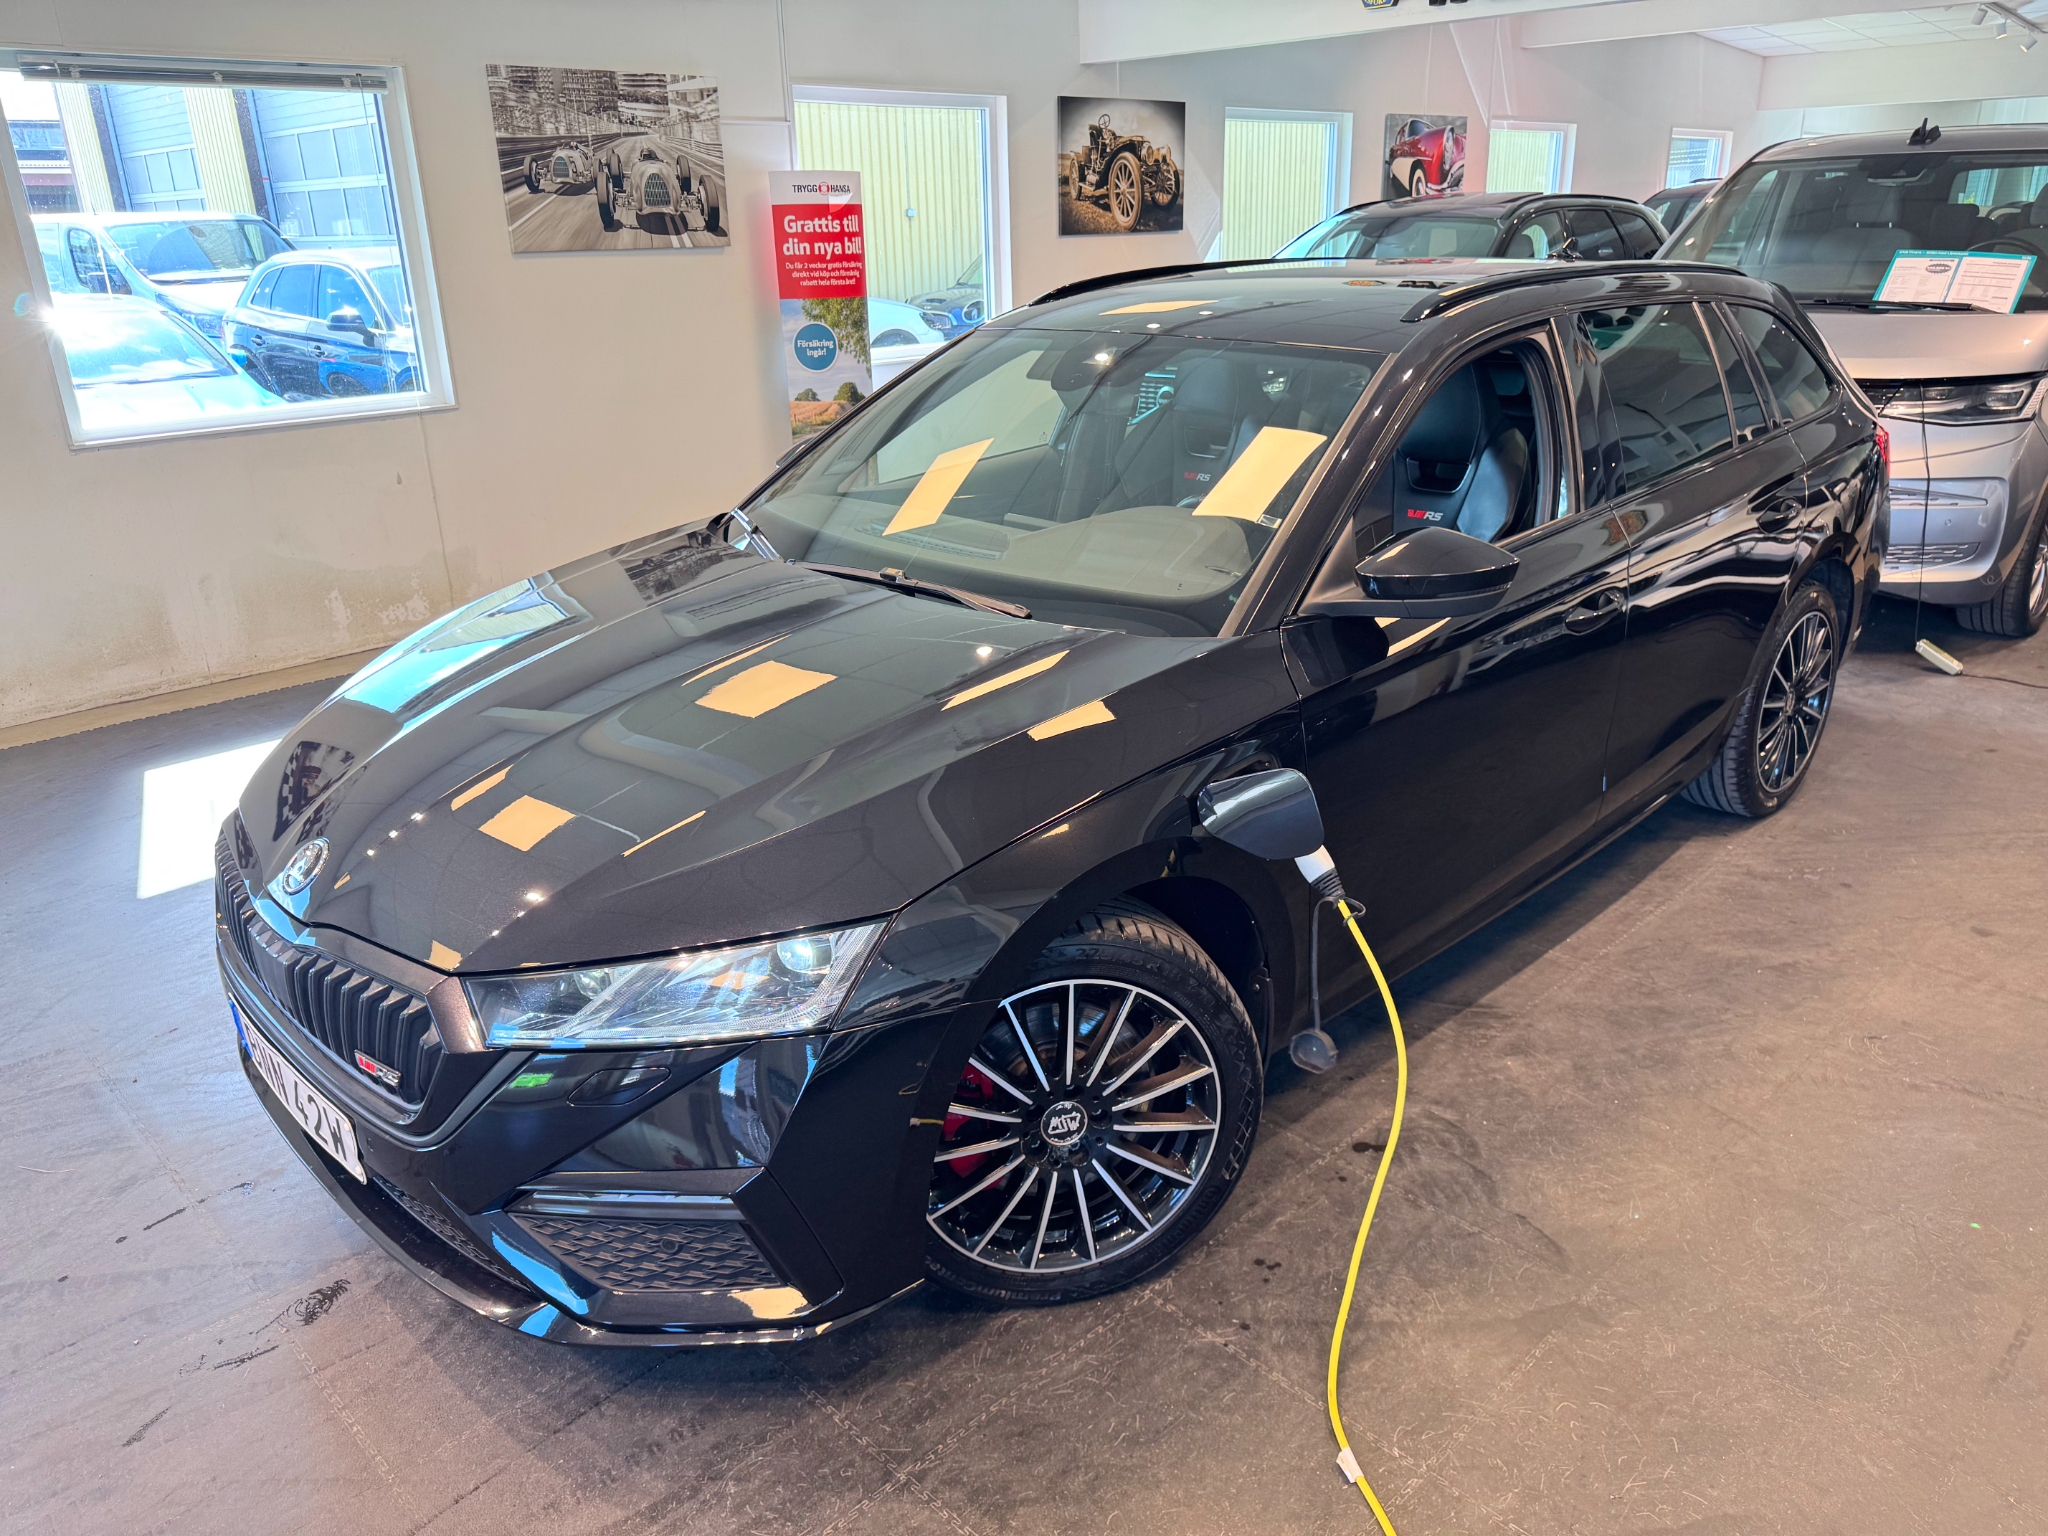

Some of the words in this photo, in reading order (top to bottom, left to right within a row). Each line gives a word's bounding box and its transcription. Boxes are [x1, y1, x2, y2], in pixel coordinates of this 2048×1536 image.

[792, 184, 818, 194] TRYGG
[830, 184, 851, 194] HANSA
[783, 215, 841, 234] Grattis
[842, 214, 859, 233] till
[782, 237, 811, 256] din
[813, 242, 843, 260] nya
[844, 236, 862, 255] bil!
[794, 261, 803, 269] får
[809, 261, 827, 269] veckor
[827, 261, 842, 271] gratis
[791, 270, 810, 278] direkt
[810, 270, 820, 278] vid
[819, 270, 830, 279] köp
[830, 269, 840, 277] och
[818, 278, 830, 286] hela
[830, 278, 846, 286] första
[797, 339, 834, 349] Försäkring
[293, 1078, 348, 1163] 42W
